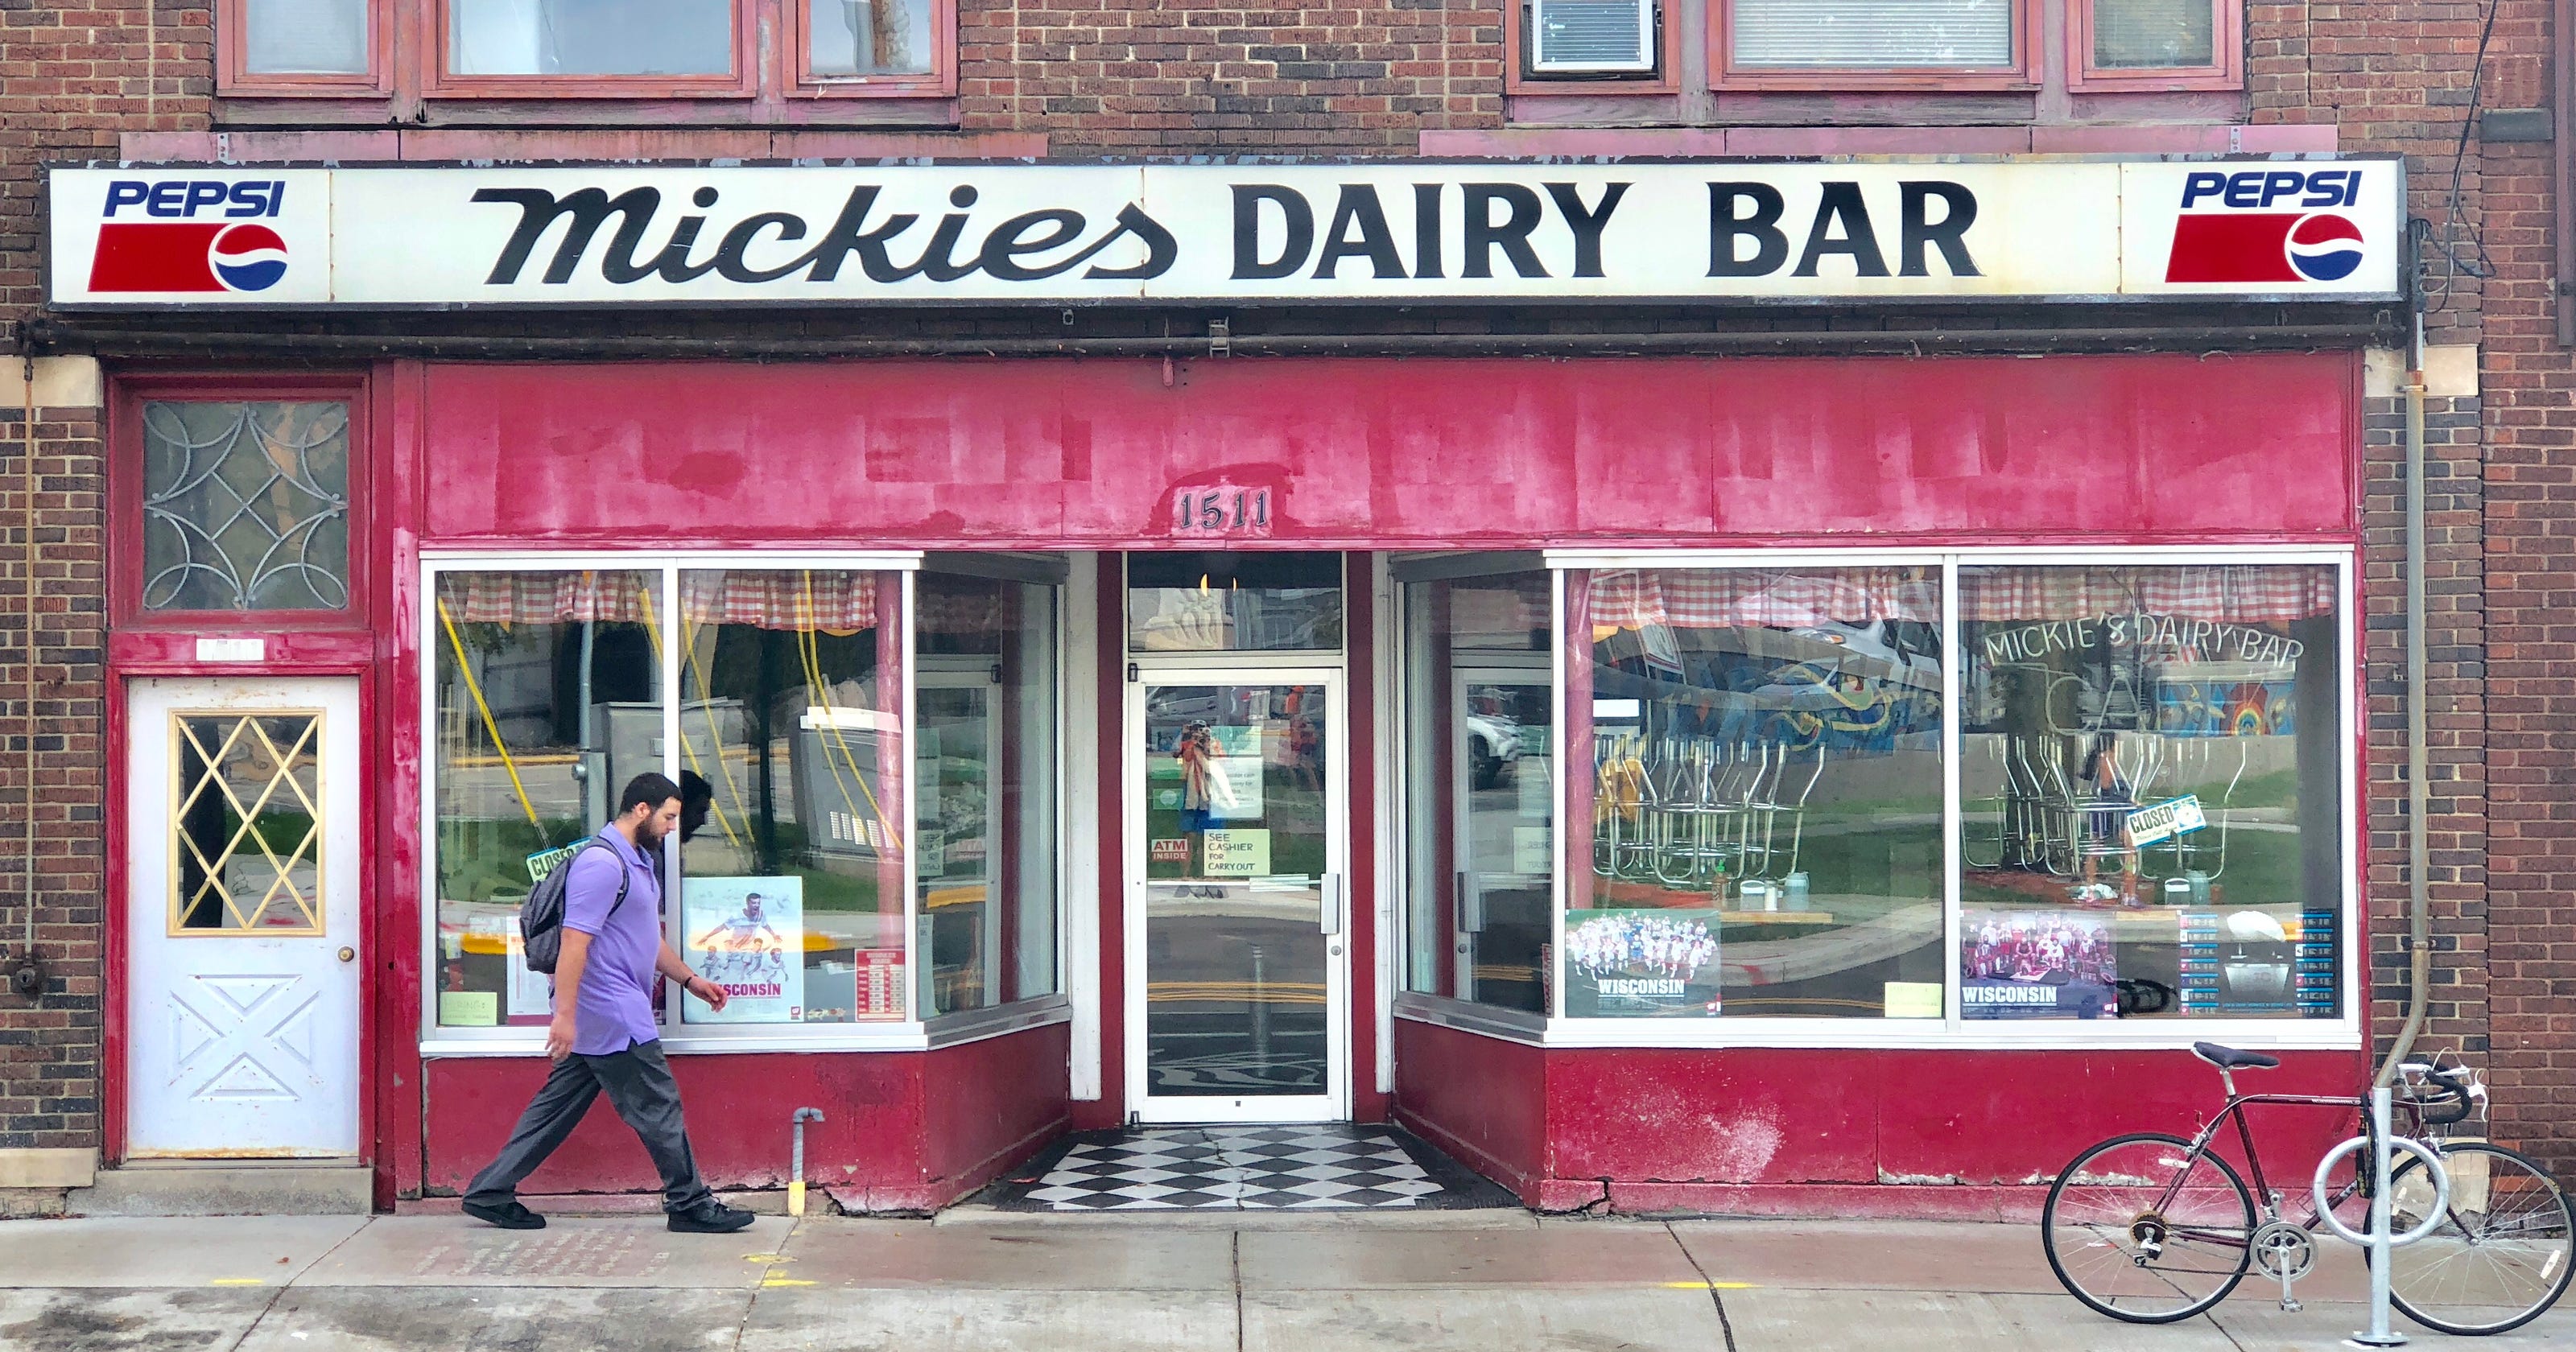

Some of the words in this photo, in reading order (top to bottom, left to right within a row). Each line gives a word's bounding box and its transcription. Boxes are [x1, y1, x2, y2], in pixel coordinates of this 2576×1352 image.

[103, 181, 286, 217] PEPSI
[2180, 171, 2363, 208] PEPSI
[469, 184, 1178, 286] Mickies
[1228, 182, 1636, 280] DAIRY
[1705, 181, 1987, 278] BAR
[1181, 491, 1267, 529] 1511
[1984, 610, 2127, 666] MICKIE'S
[2136, 613, 2235, 660] DAIRY
[2240, 627, 2304, 670] BAR
[2129, 806, 2174, 834] CLOSED
[1154, 840, 1185, 851] ATM
[1208, 833, 1230, 842] SEE
[1208, 843, 1253, 851] CASHIER
[720, 983, 781, 996] SCONSIN
[1598, 979, 1685, 995] WISCONSIN
[1962, 987, 2057, 1003] WISCONSIN
